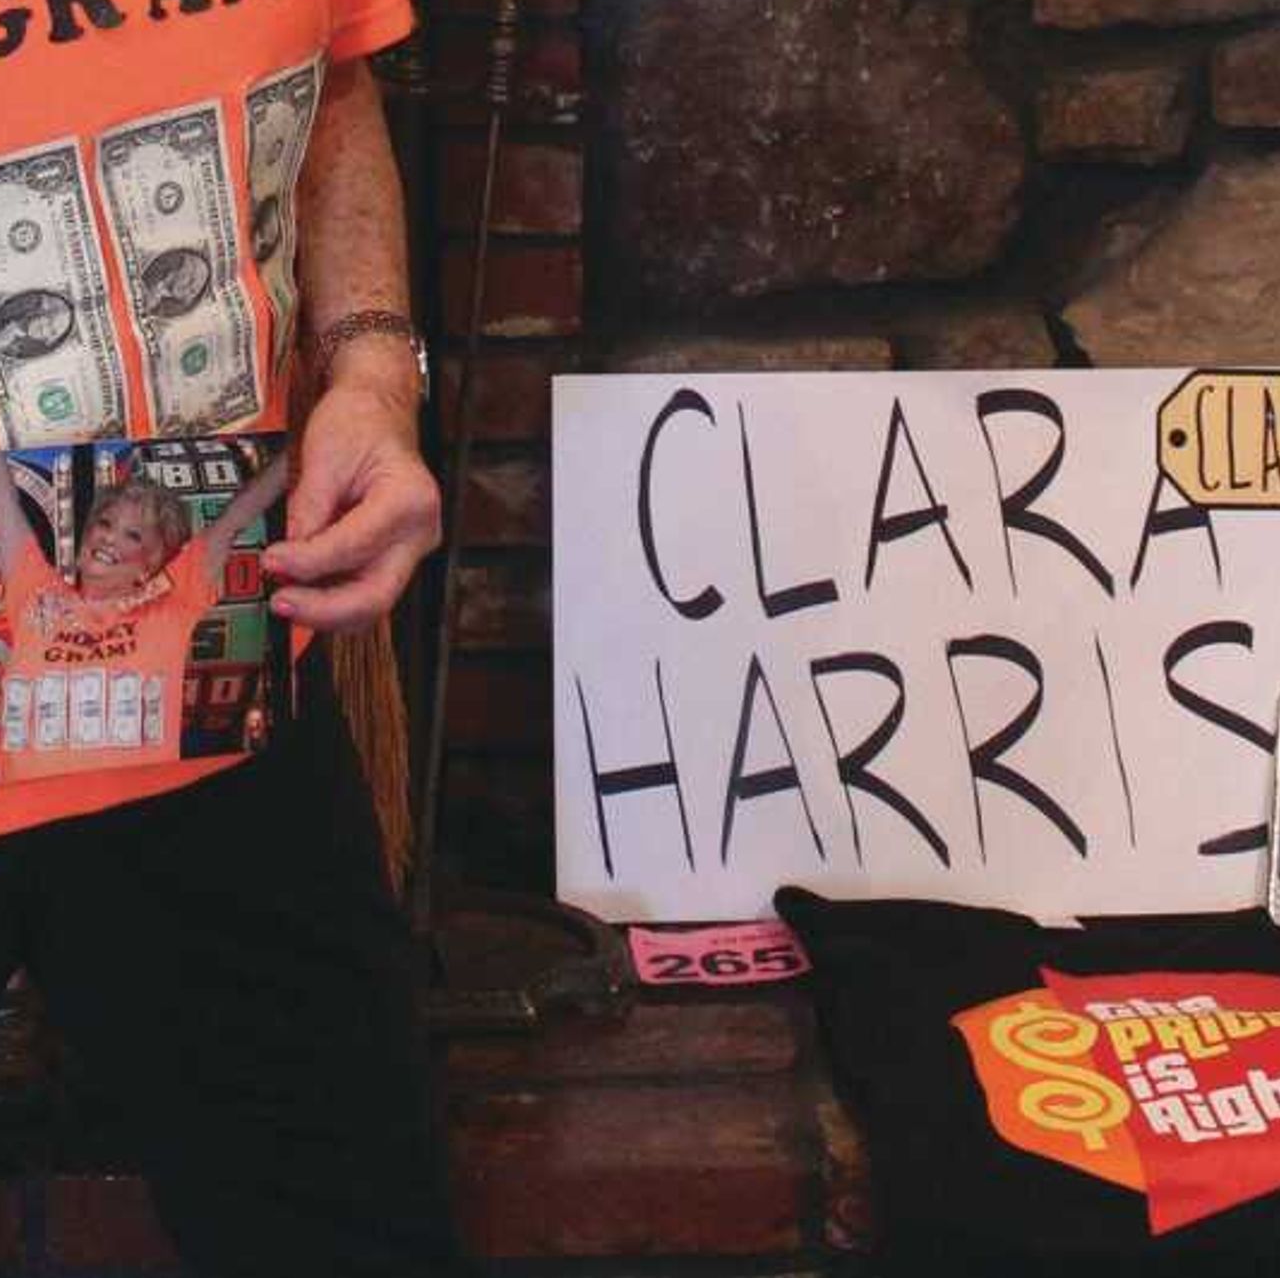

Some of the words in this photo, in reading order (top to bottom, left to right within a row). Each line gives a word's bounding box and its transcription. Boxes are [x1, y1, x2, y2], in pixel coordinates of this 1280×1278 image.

[637, 388, 1222, 620] CLARA
[646, 944, 804, 979] 265
[1123, 1052, 1198, 1101] is
